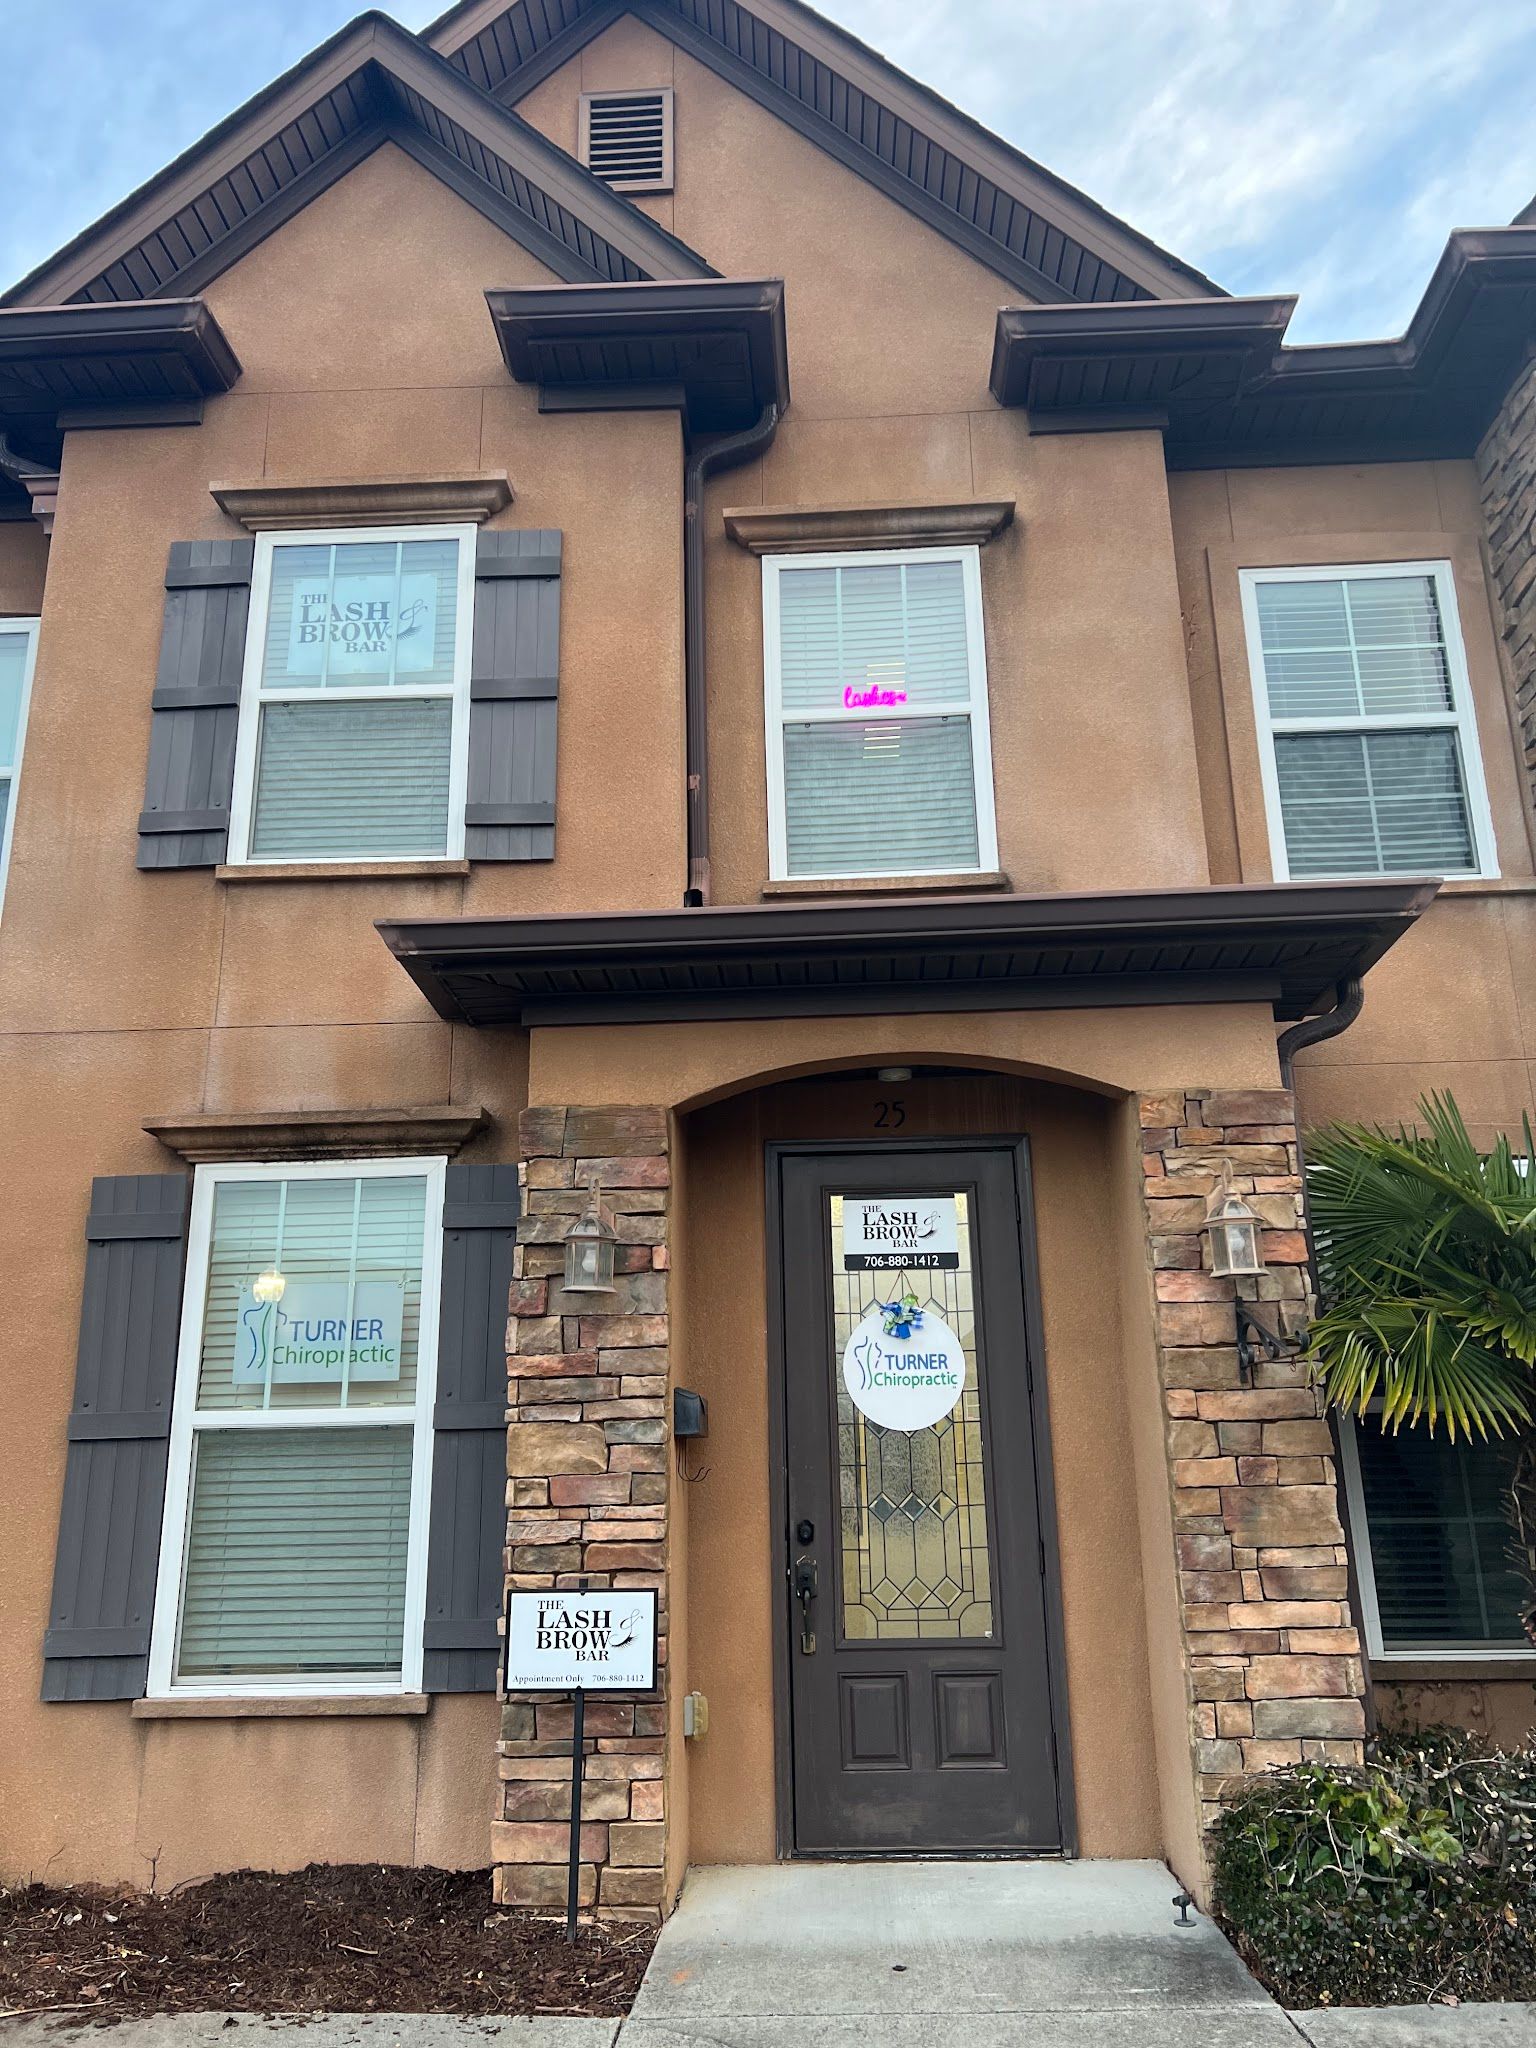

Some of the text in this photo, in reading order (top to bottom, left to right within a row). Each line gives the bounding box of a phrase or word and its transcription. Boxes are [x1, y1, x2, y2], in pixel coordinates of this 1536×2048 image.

[300, 601, 390, 623] LASH
[298, 621, 390, 643] BROW
[344, 640, 387, 653] BAR
[874, 1101, 905, 1128] 25
[862, 1205, 882, 1213] THE
[862, 1211, 918, 1226] LASH
[863, 1225, 918, 1240] BROW
[892, 1239, 918, 1248] BAR
[864, 1255, 940, 1268] 706-880-1412
[289, 1319, 383, 1342] TURNER
[273, 1345, 395, 1368] Chiropractic
[884, 1353, 949, 1370] TURNER
[874, 1371, 958, 1389] Chiropractic
[537, 1600, 564, 1610] THE
[537, 1610, 612, 1629] LASH
[536, 1630, 611, 1649] BROW
[575, 1650, 610, 1661] BAR
[513, 1674, 645, 1684] Appointment Only 706-880-1412
